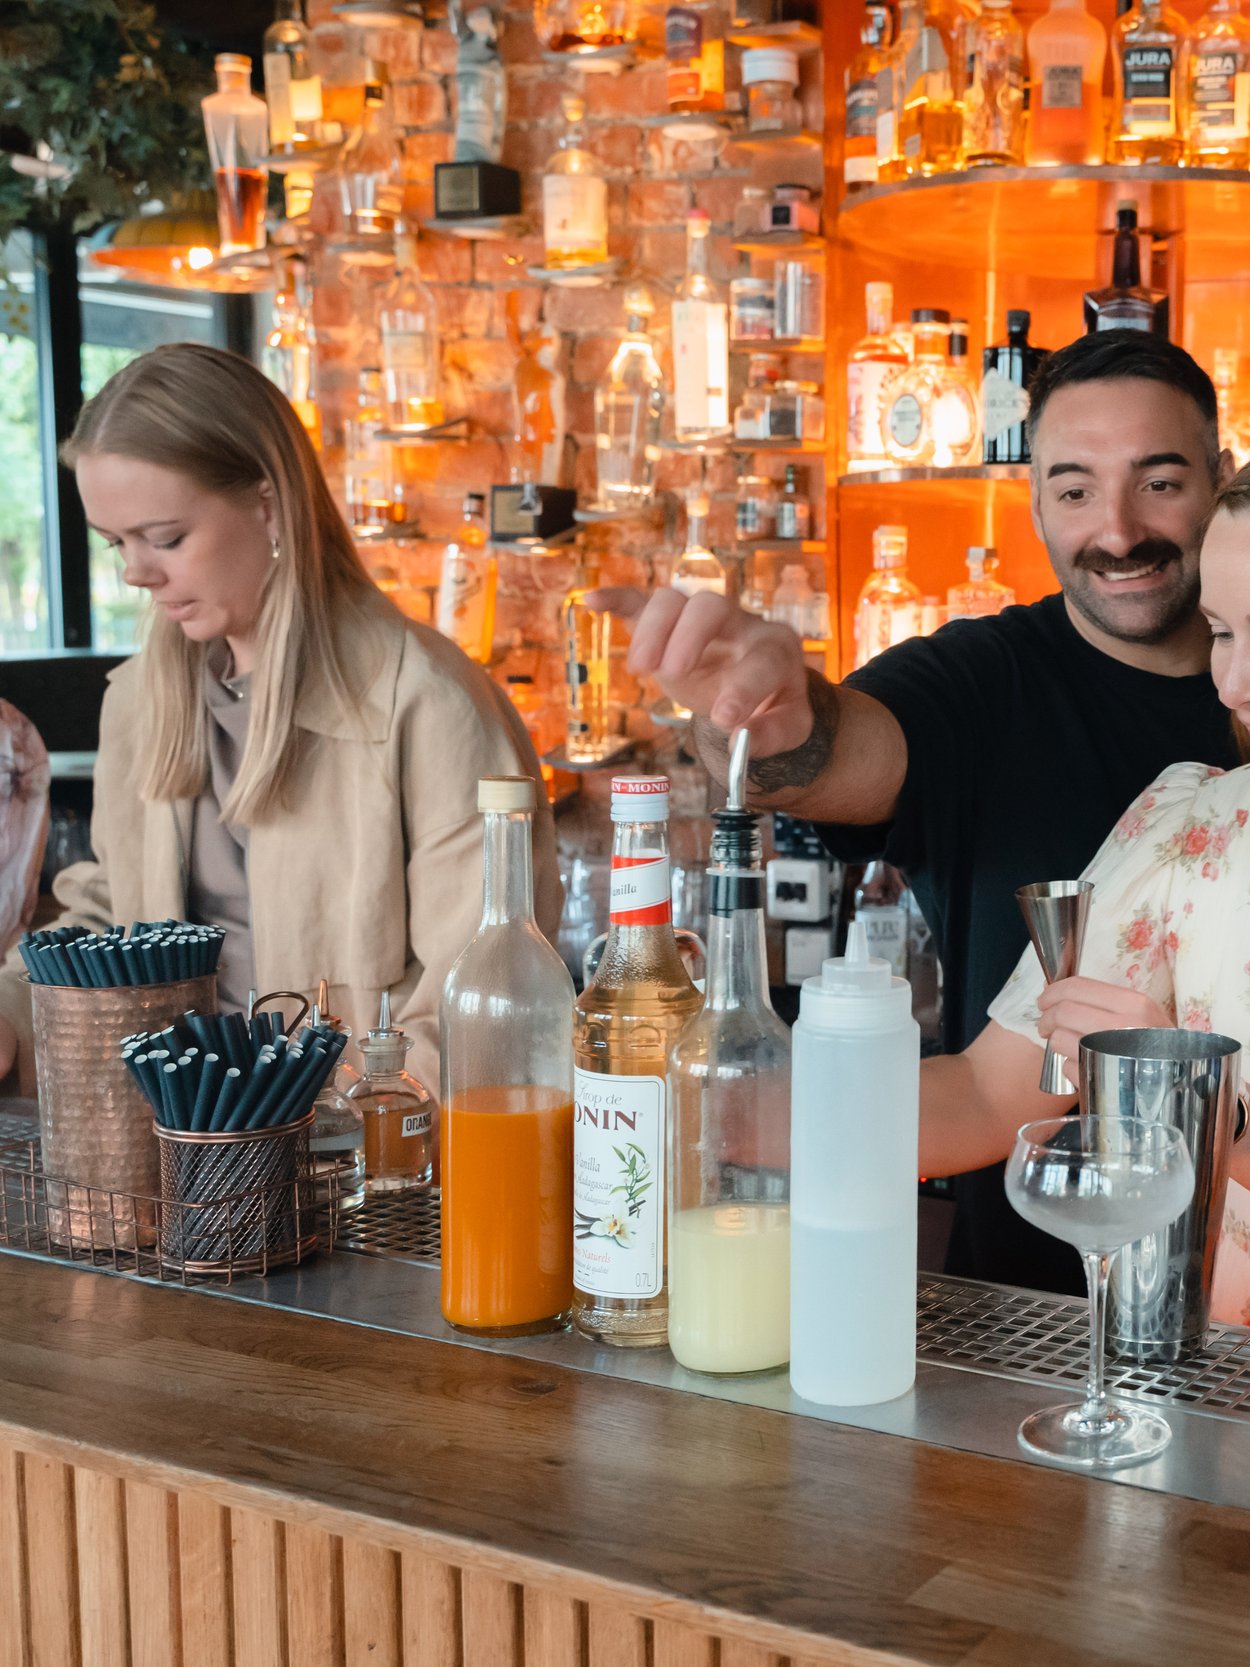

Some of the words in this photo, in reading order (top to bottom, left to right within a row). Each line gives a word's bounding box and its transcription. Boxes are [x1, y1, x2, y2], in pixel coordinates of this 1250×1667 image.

[1125, 51, 1171, 66] JURA
[628, 783, 670, 793] MONIN
[605, 1094, 622, 1105] de
[583, 1251, 612, 1264] Naturels
